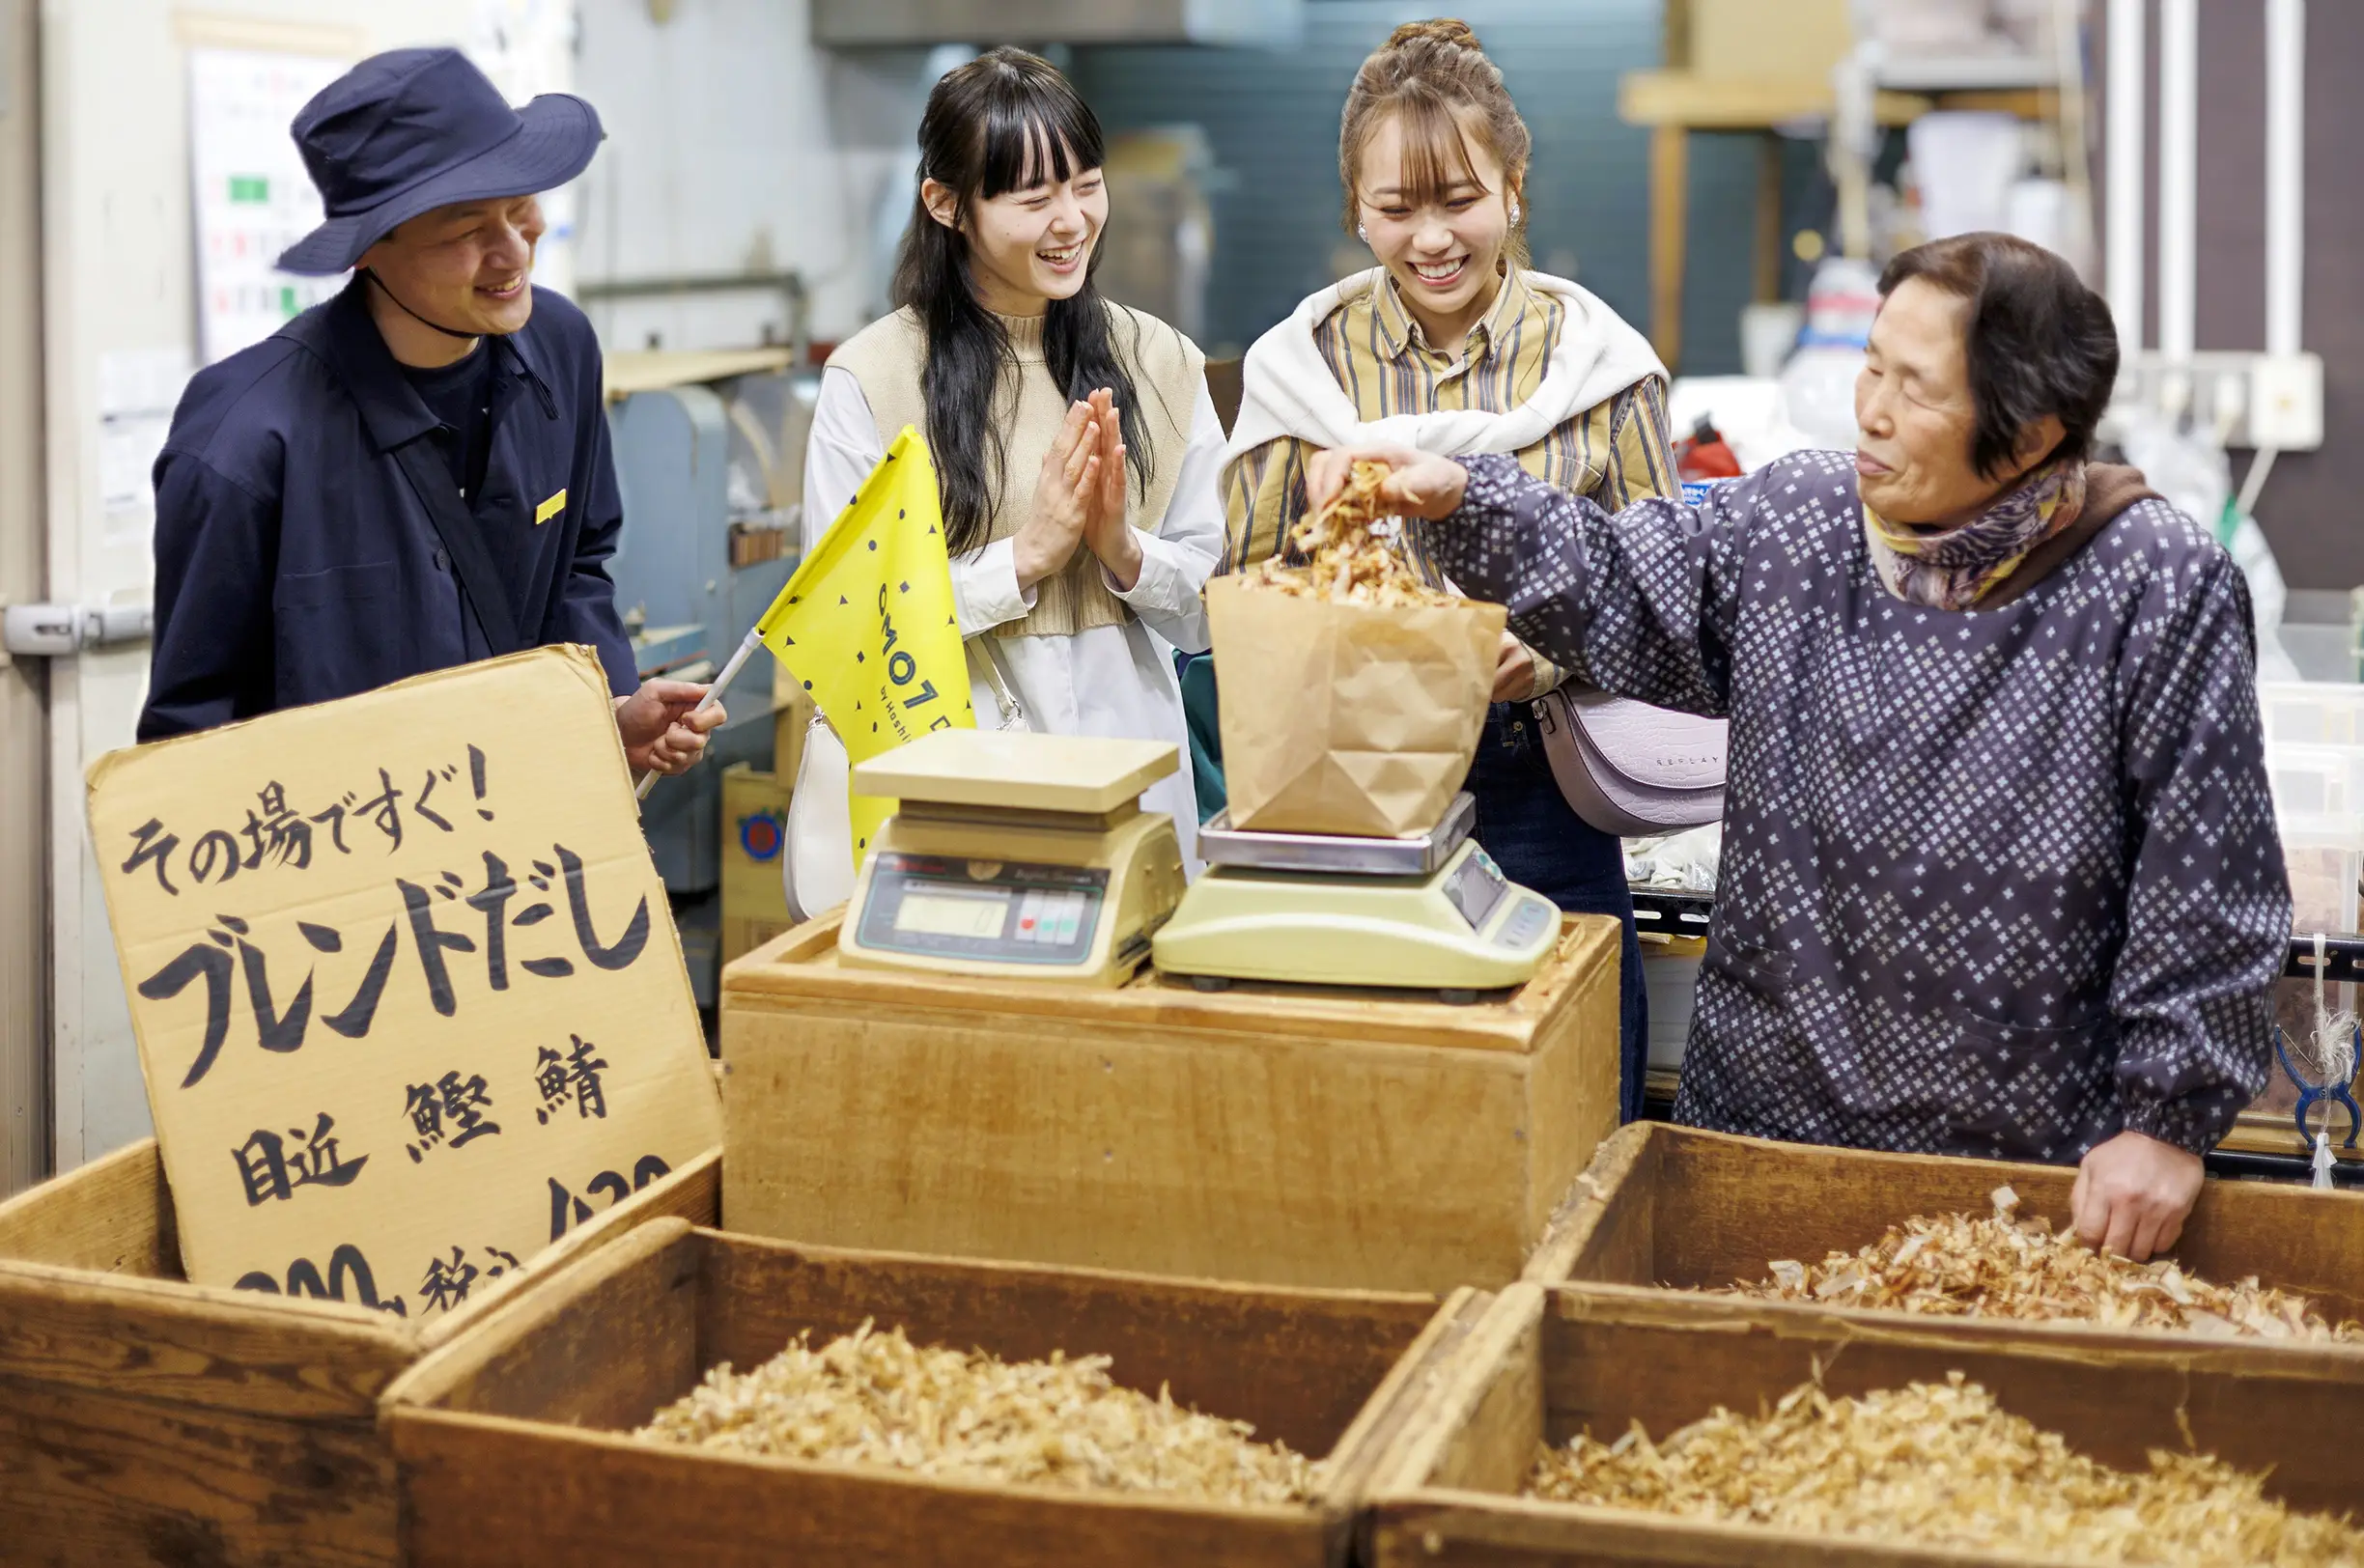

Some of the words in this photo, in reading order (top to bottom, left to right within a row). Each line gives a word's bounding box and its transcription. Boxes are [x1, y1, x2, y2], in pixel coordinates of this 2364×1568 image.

[879, 582, 939, 710] OMO7
[881, 685, 888, 701] by
[886, 700, 911, 742] Hoshi
[122, 742, 494, 896] その場ですぐ!
[1656, 756, 1719, 766] REPLAY
[137, 843, 651, 1089] ブレンドだし
[232, 1111, 370, 1206] 目近
[403, 1071, 501, 1164] 鰹
[534, 1033, 609, 1126] 鯖
